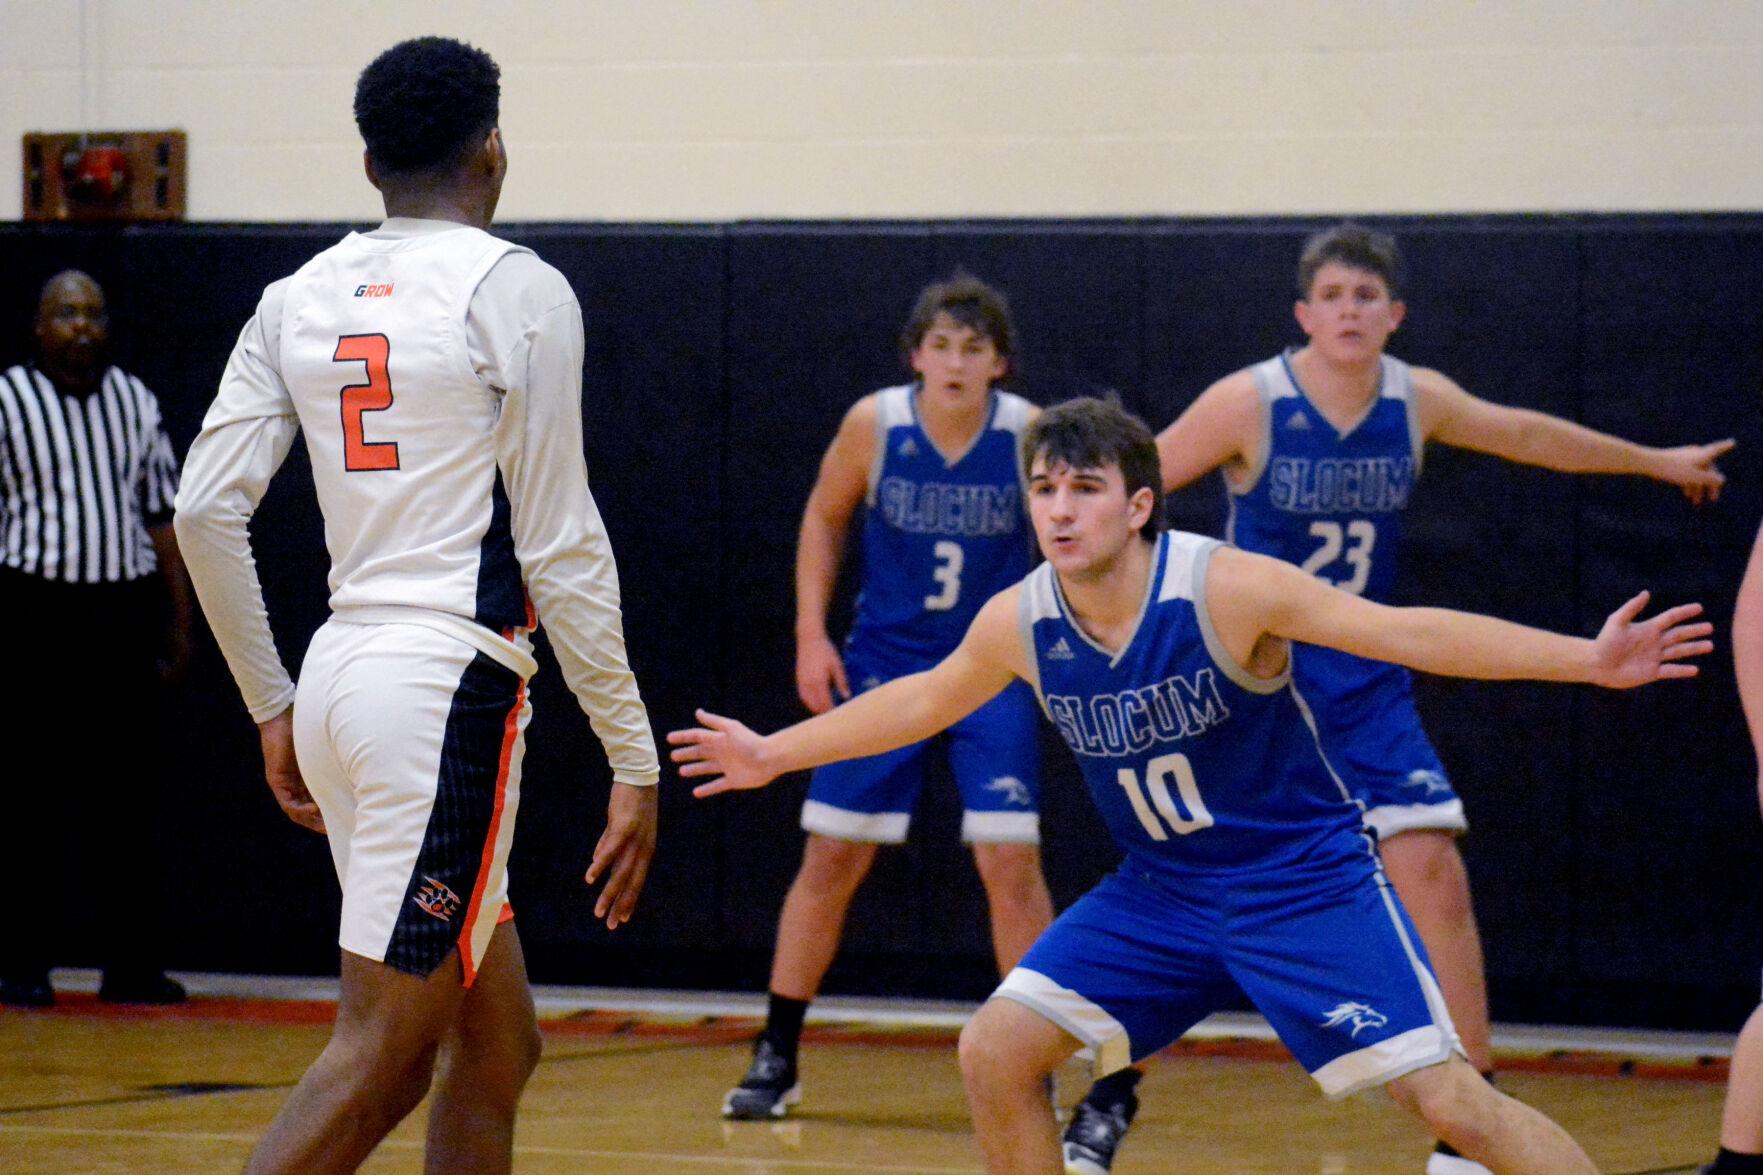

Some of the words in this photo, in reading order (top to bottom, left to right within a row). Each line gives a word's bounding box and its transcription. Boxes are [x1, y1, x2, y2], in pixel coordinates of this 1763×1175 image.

[353, 283, 395, 298] GROW
[332, 332, 401, 472] 2
[880, 475, 1020, 537] SLOCUM
[1269, 456, 1414, 514] SLOCUM
[923, 540, 965, 612] 3
[1299, 520, 1377, 595] 23
[1046, 667, 1230, 757] SLOCUM
[1117, 752, 1215, 841] 10
